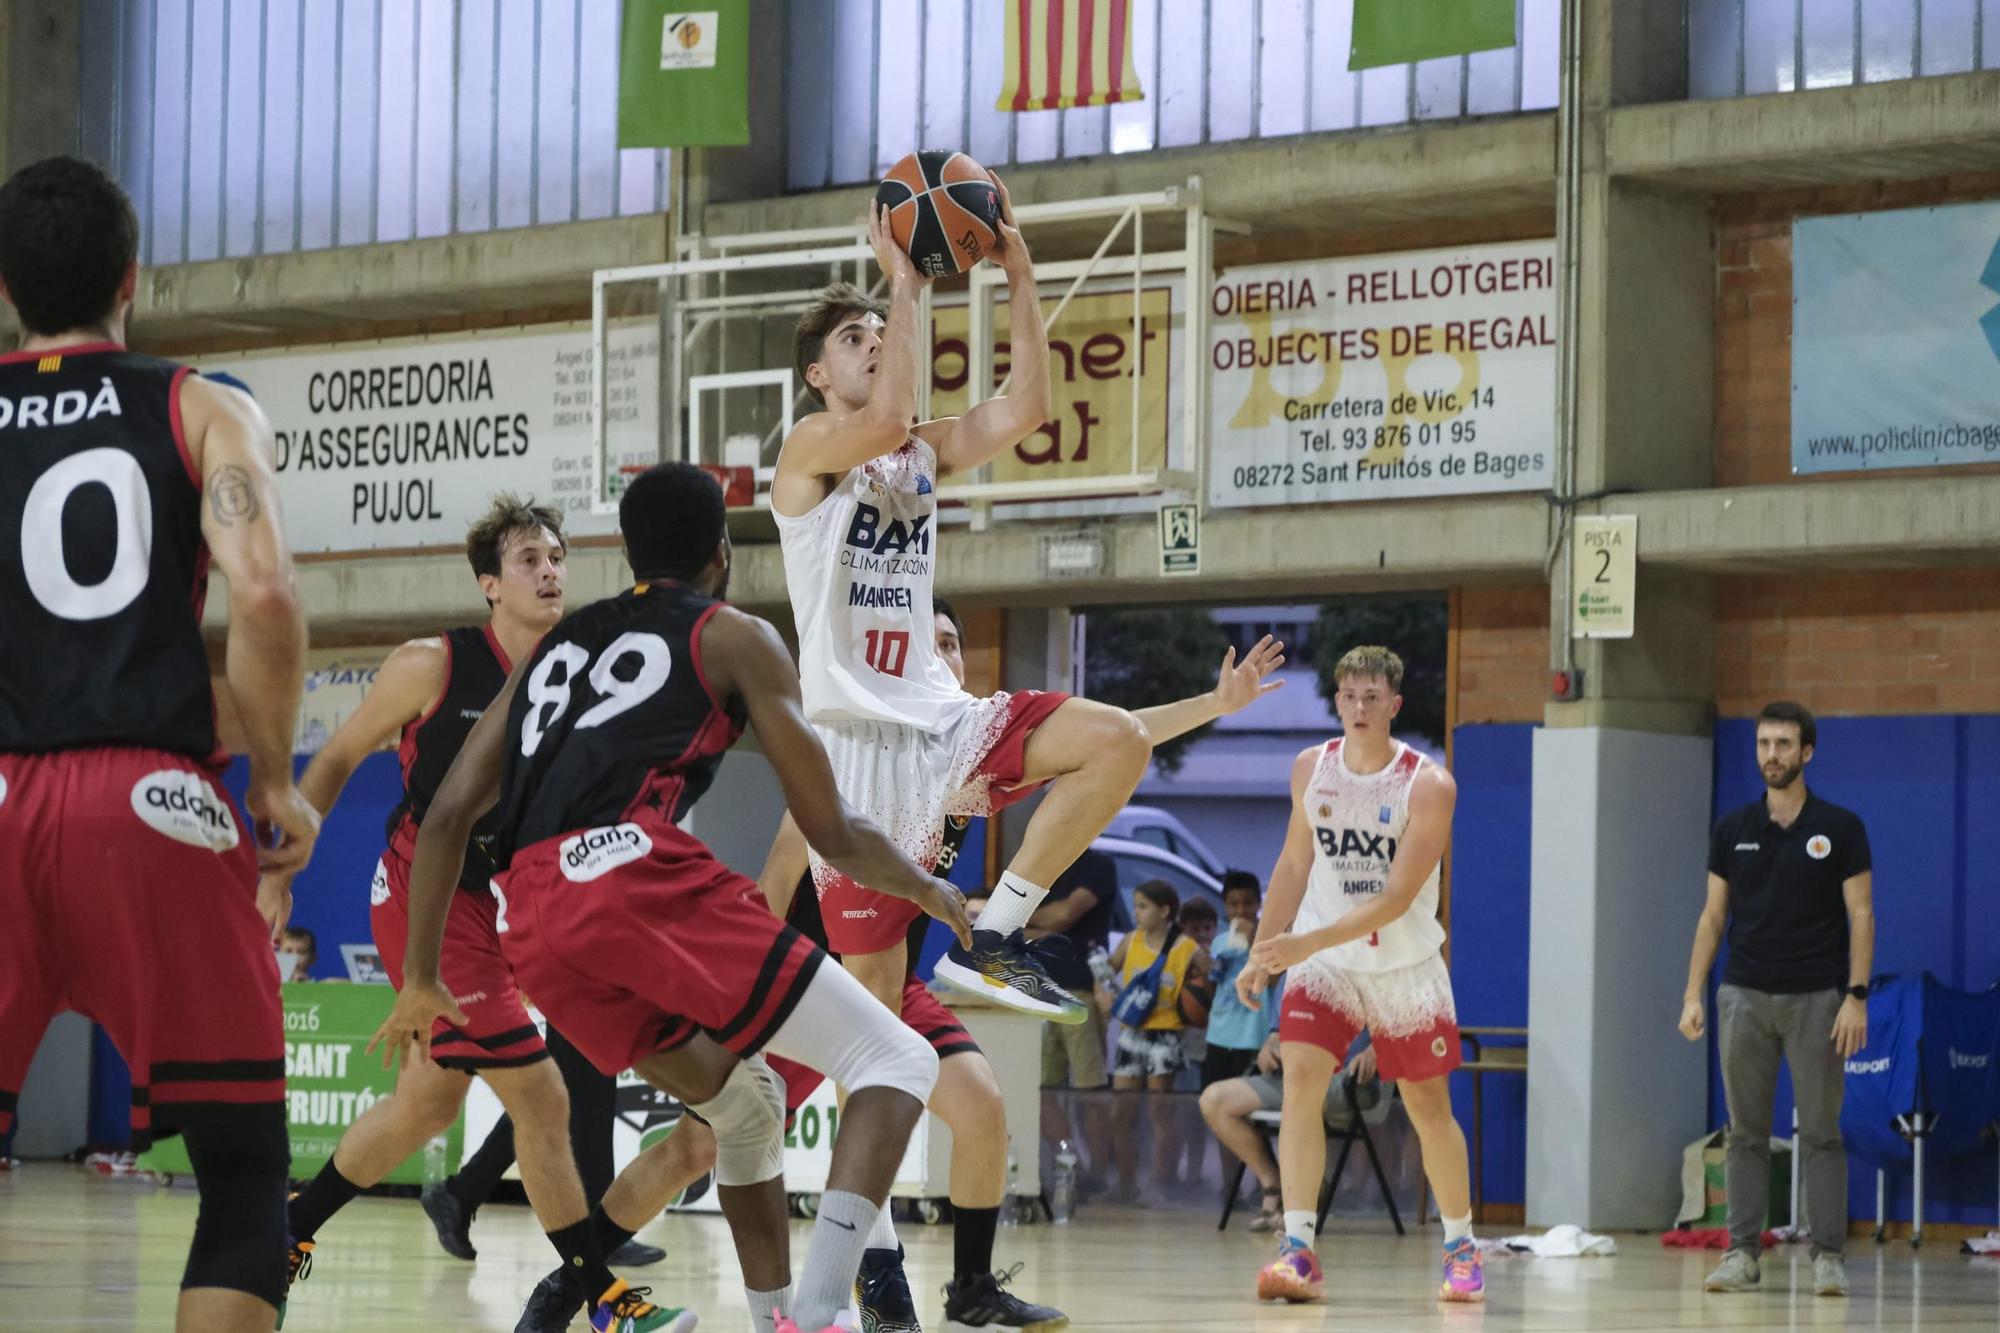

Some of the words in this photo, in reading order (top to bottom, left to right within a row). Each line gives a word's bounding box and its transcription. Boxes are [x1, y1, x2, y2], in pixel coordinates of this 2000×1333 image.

[1213, 327, 1380, 371] OBJECTES
[1391, 322, 1433, 358] DE
[308, 357, 494, 414] CORREDORIA
[1284, 397, 1384, 422] Carretera
[1391, 392, 1418, 415] de
[1424, 388, 1464, 415] Vic,
[1471, 386, 1495, 409] 14
[275, 412, 529, 472] D'ASSEGURANCES
[1300, 427, 1336, 453] Tel.
[1342, 428, 1367, 450] 93
[1374, 426, 1412, 448] 876
[1418, 422, 1442, 446] 01
[1450, 420, 1477, 443] 95
[1233, 463, 1295, 488] 08272
[1301, 460, 1349, 485] Sant
[1356, 451, 1433, 481] Fruitós
[1439, 452, 1466, 476] de
[1473, 450, 1545, 480] Bages
[352, 478, 442, 525] PUJOL
[21, 446, 153, 621] 0
[1585, 529, 1623, 547] PISTA
[1595, 548, 1611, 584] 2
[865, 629, 909, 679] 10
[521, 631, 672, 758] 89
